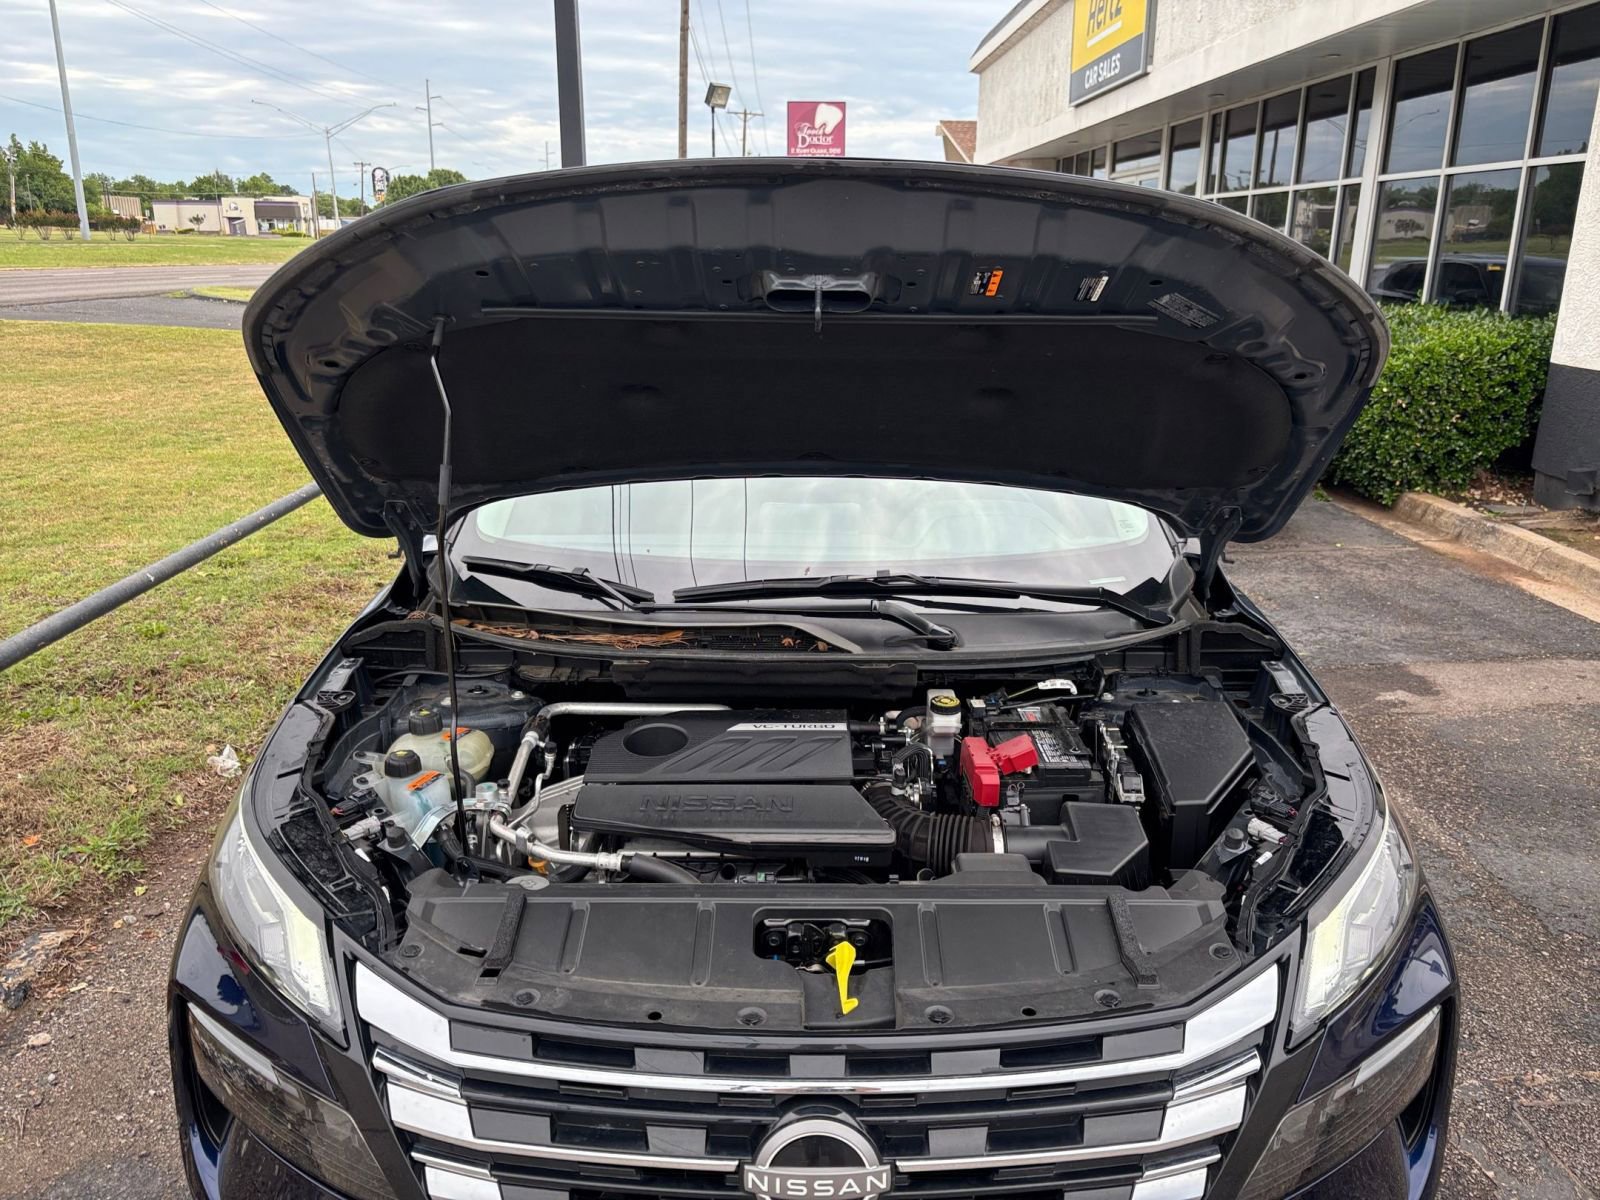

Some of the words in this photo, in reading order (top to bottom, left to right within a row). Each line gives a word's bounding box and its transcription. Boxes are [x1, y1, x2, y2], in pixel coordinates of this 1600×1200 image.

[1086, 0, 1122, 37] Hertz
[1084, 65, 1098, 89] CAR
[1098, 52, 1121, 82] SALES
[797, 134, 833, 148] Doctor
[639, 794, 794, 813] NISSAN
[747, 1172, 888, 1197] NISSAN
